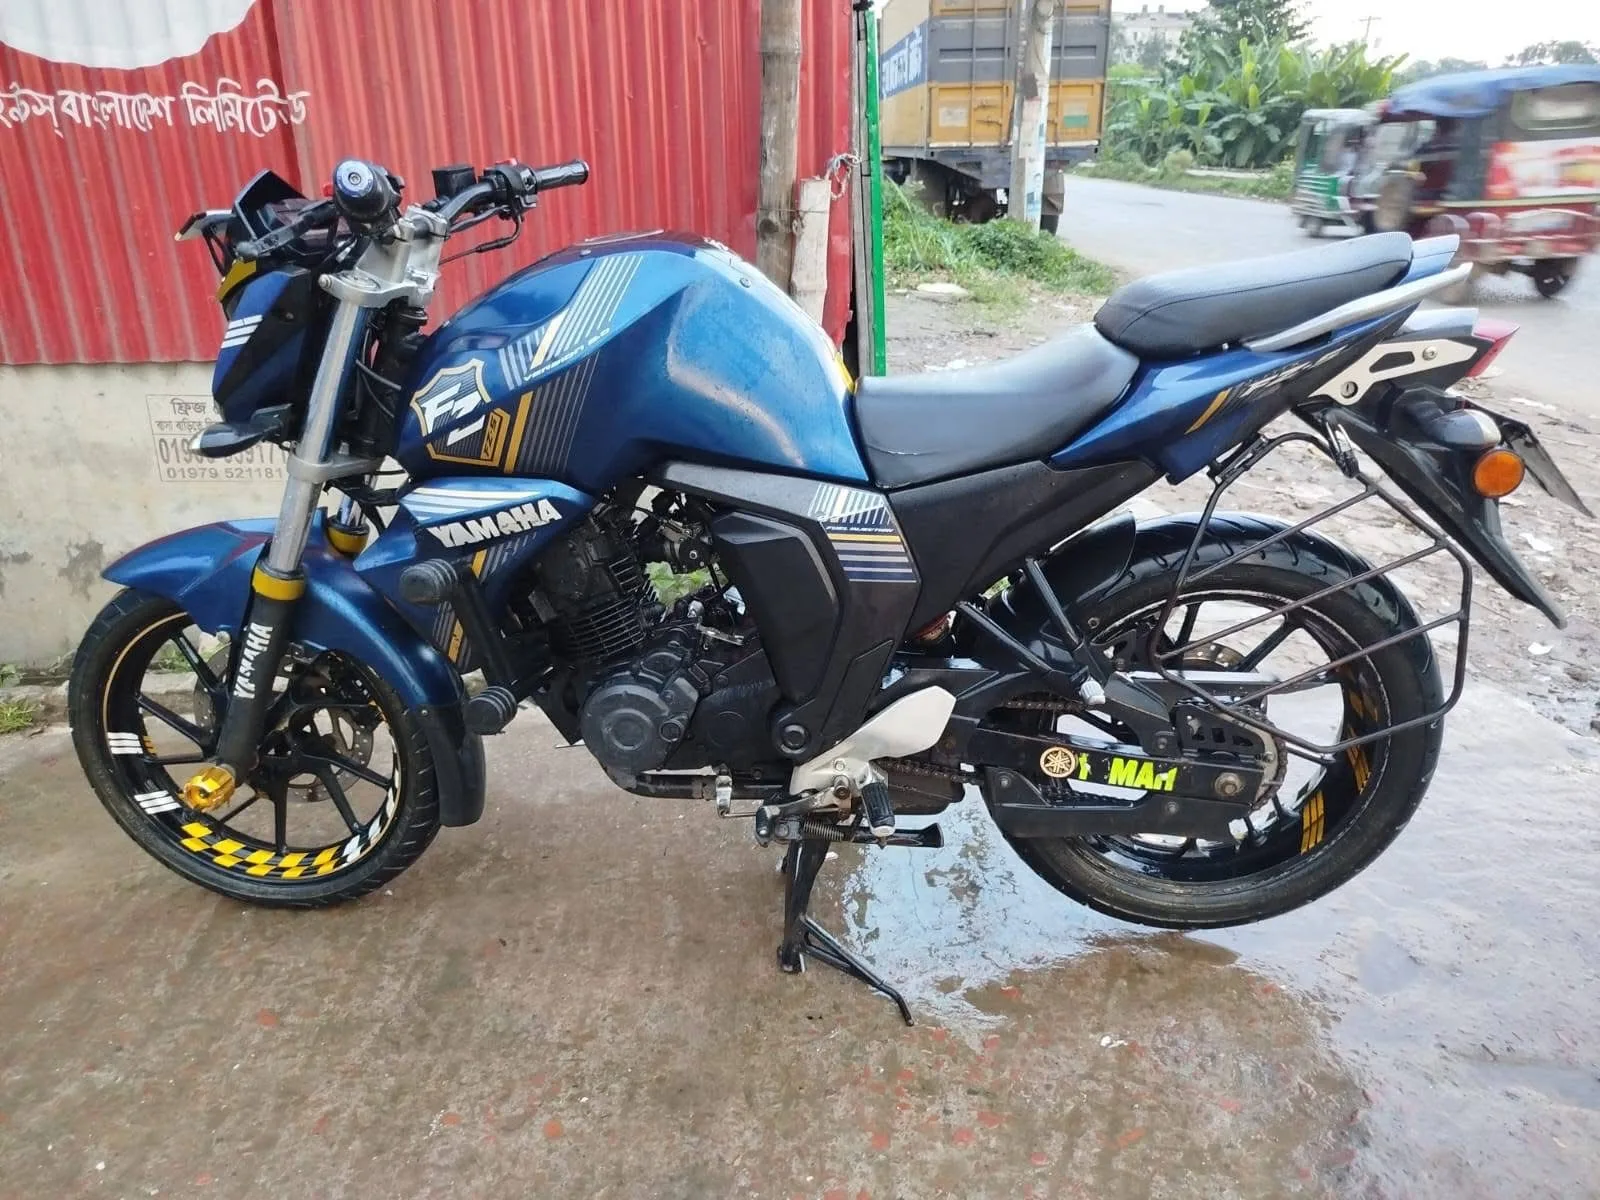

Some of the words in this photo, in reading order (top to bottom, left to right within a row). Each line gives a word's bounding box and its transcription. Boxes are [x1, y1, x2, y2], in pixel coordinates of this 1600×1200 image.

[167, 467, 218, 479] 01979
[224, 467, 283, 479] 521181
[427, 498, 562, 548] YAMAHA
[233, 622, 273, 699] YAMAHA
